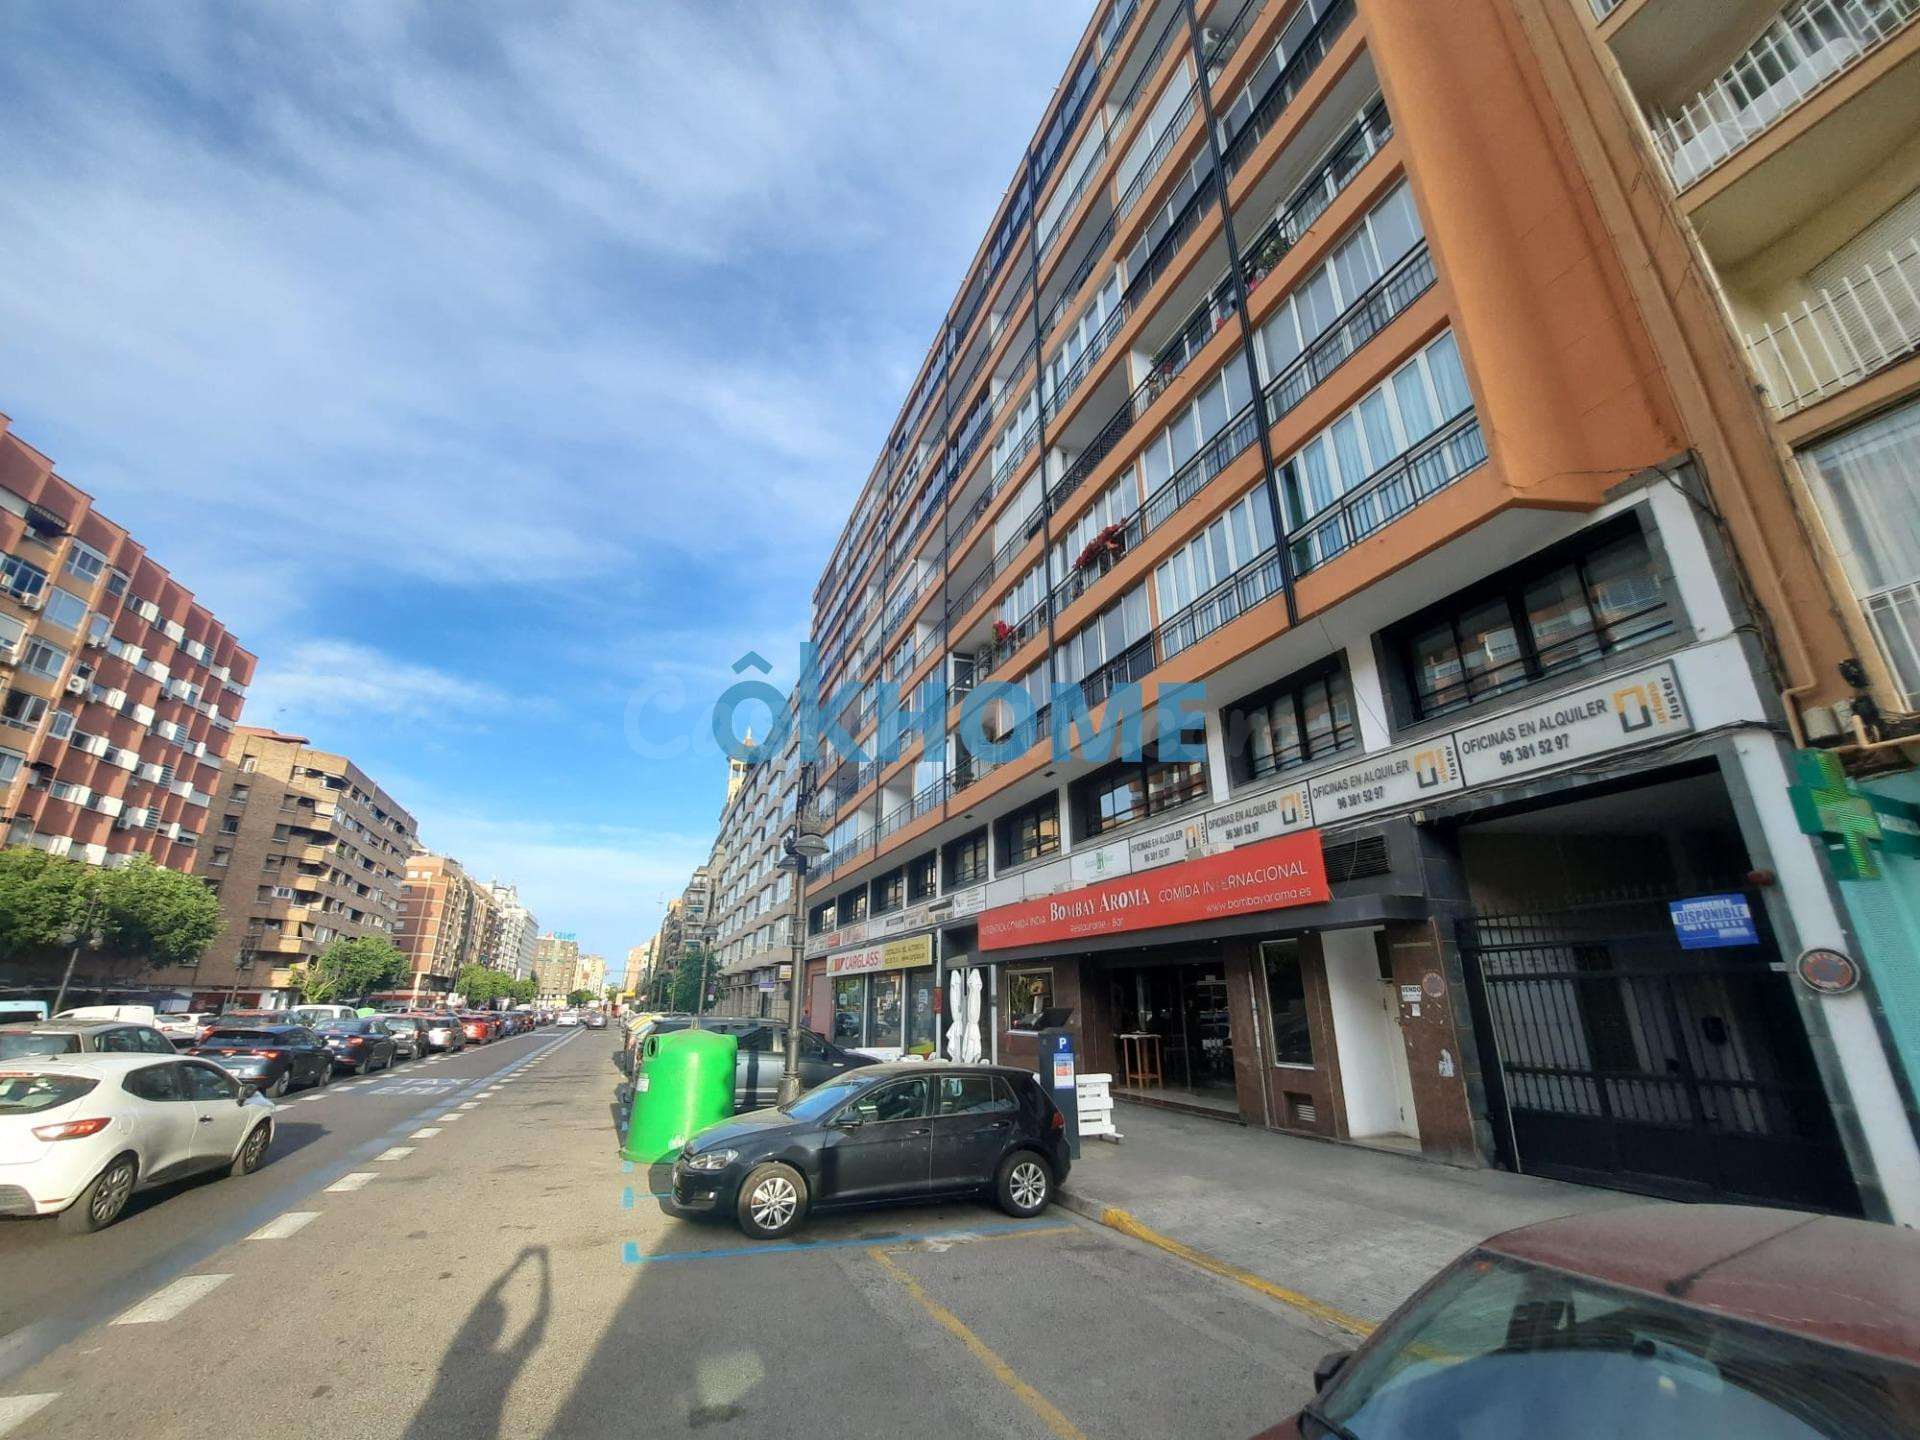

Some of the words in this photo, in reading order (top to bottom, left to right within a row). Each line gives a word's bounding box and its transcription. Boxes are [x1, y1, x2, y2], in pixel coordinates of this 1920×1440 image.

[1661, 676, 1683, 720] fuster
[1461, 727, 1517, 755] OFICINAS
[1518, 721, 1537, 737] EN
[1538, 699, 1608, 732] ALQUILER
[1499, 749, 1514, 766] 96
[1515, 744, 1536, 761] 381
[1537, 738, 1554, 755] 52
[1554, 733, 1570, 750] 97
[1312, 778, 1349, 800] OFICINAS
[1349, 774, 1362, 787] EN
[1363, 759, 1410, 783] ALQUILER
[1337, 798, 1347, 810] 96
[1362, 789, 1373, 803] 52
[1373, 786, 1384, 800] 97
[1208, 813, 1235, 831] OFICINAS
[1235, 810, 1244, 822] EN
[1244, 800, 1278, 819] ALQUILER
[1100, 887, 1150, 913] AROMA
[1158, 884, 1200, 903] COMIDA
[1203, 860, 1308, 895] INERNACIONAL
[1676, 905, 1745, 923] DISPONIBLE
[844, 951, 880, 970] CARGLASS
[1059, 1037, 1067, 1050] P
